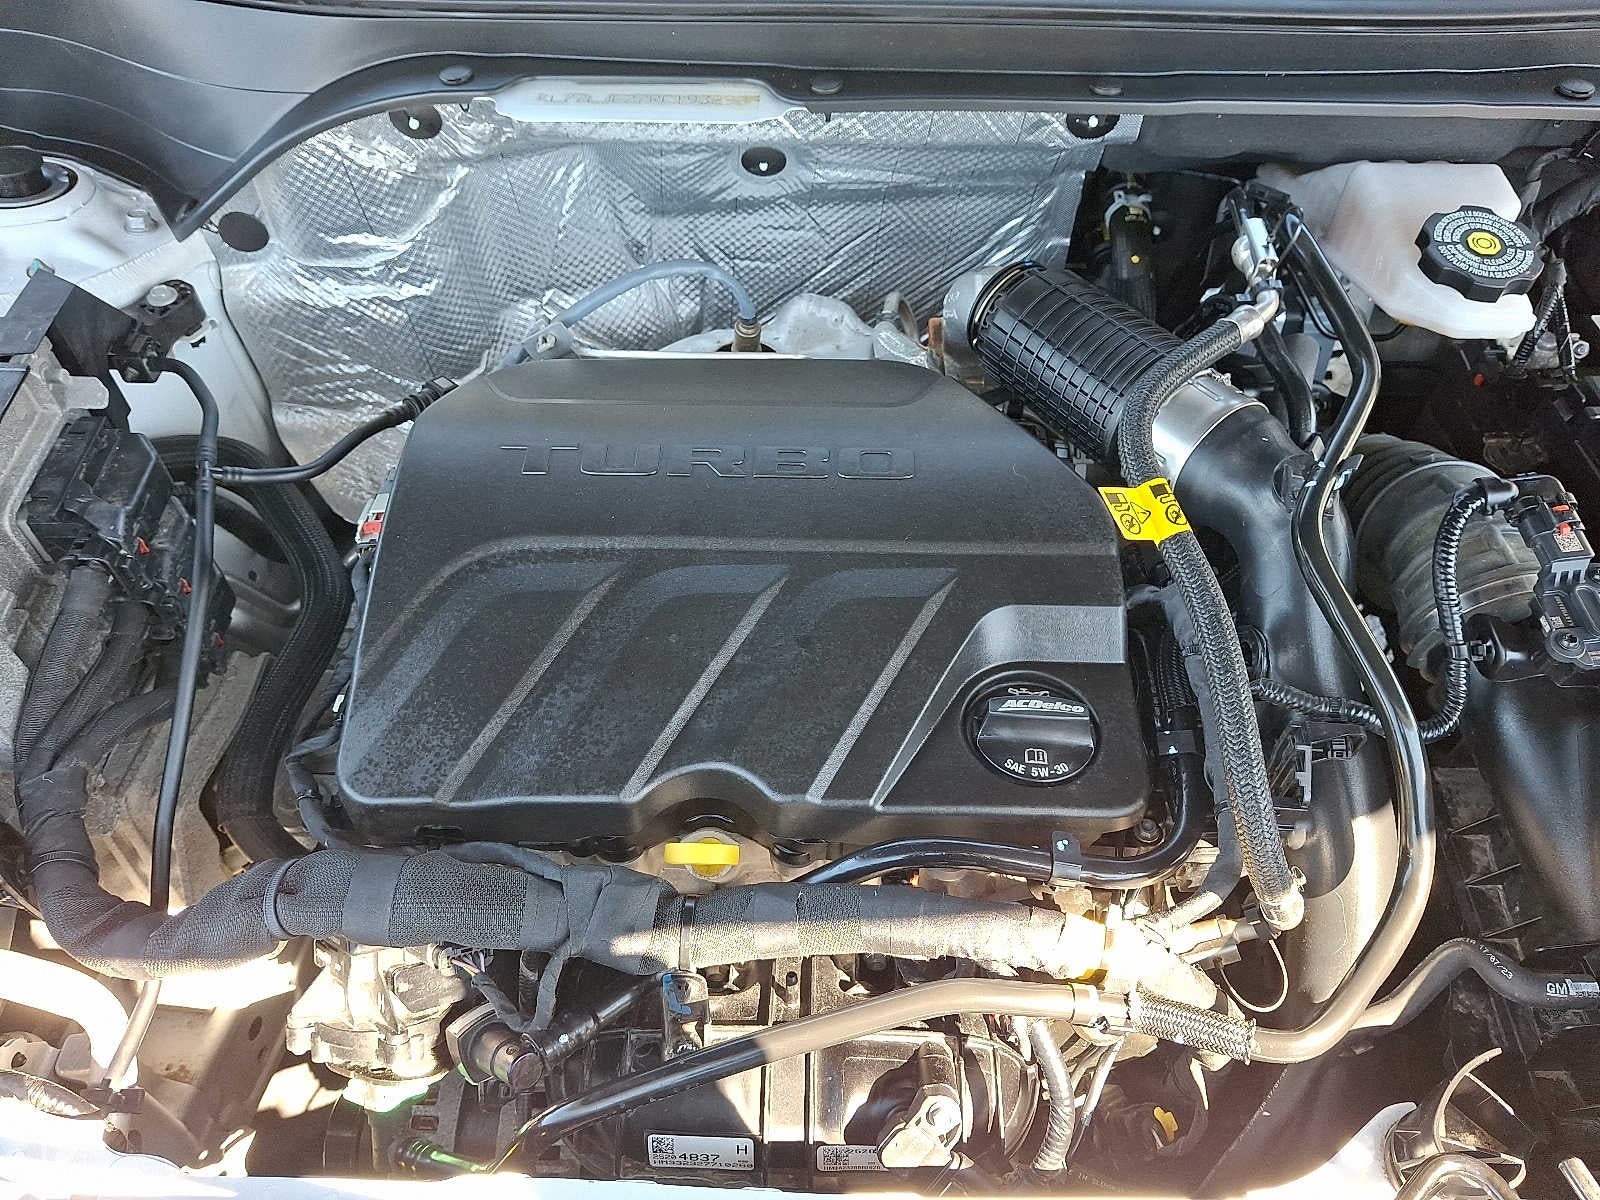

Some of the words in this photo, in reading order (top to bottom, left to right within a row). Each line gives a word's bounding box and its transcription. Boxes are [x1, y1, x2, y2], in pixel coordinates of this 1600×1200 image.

[500, 444, 916, 478] TURBO
[1000, 699, 1084, 713] ACDelco
[1004, 758, 1027, 775] SAE
[1031, 762, 1069, 777] 5W-30
[1546, 982, 1568, 996] GM
[736, 1144, 748, 1155] H
[678, 1152, 720, 1162] 4837
